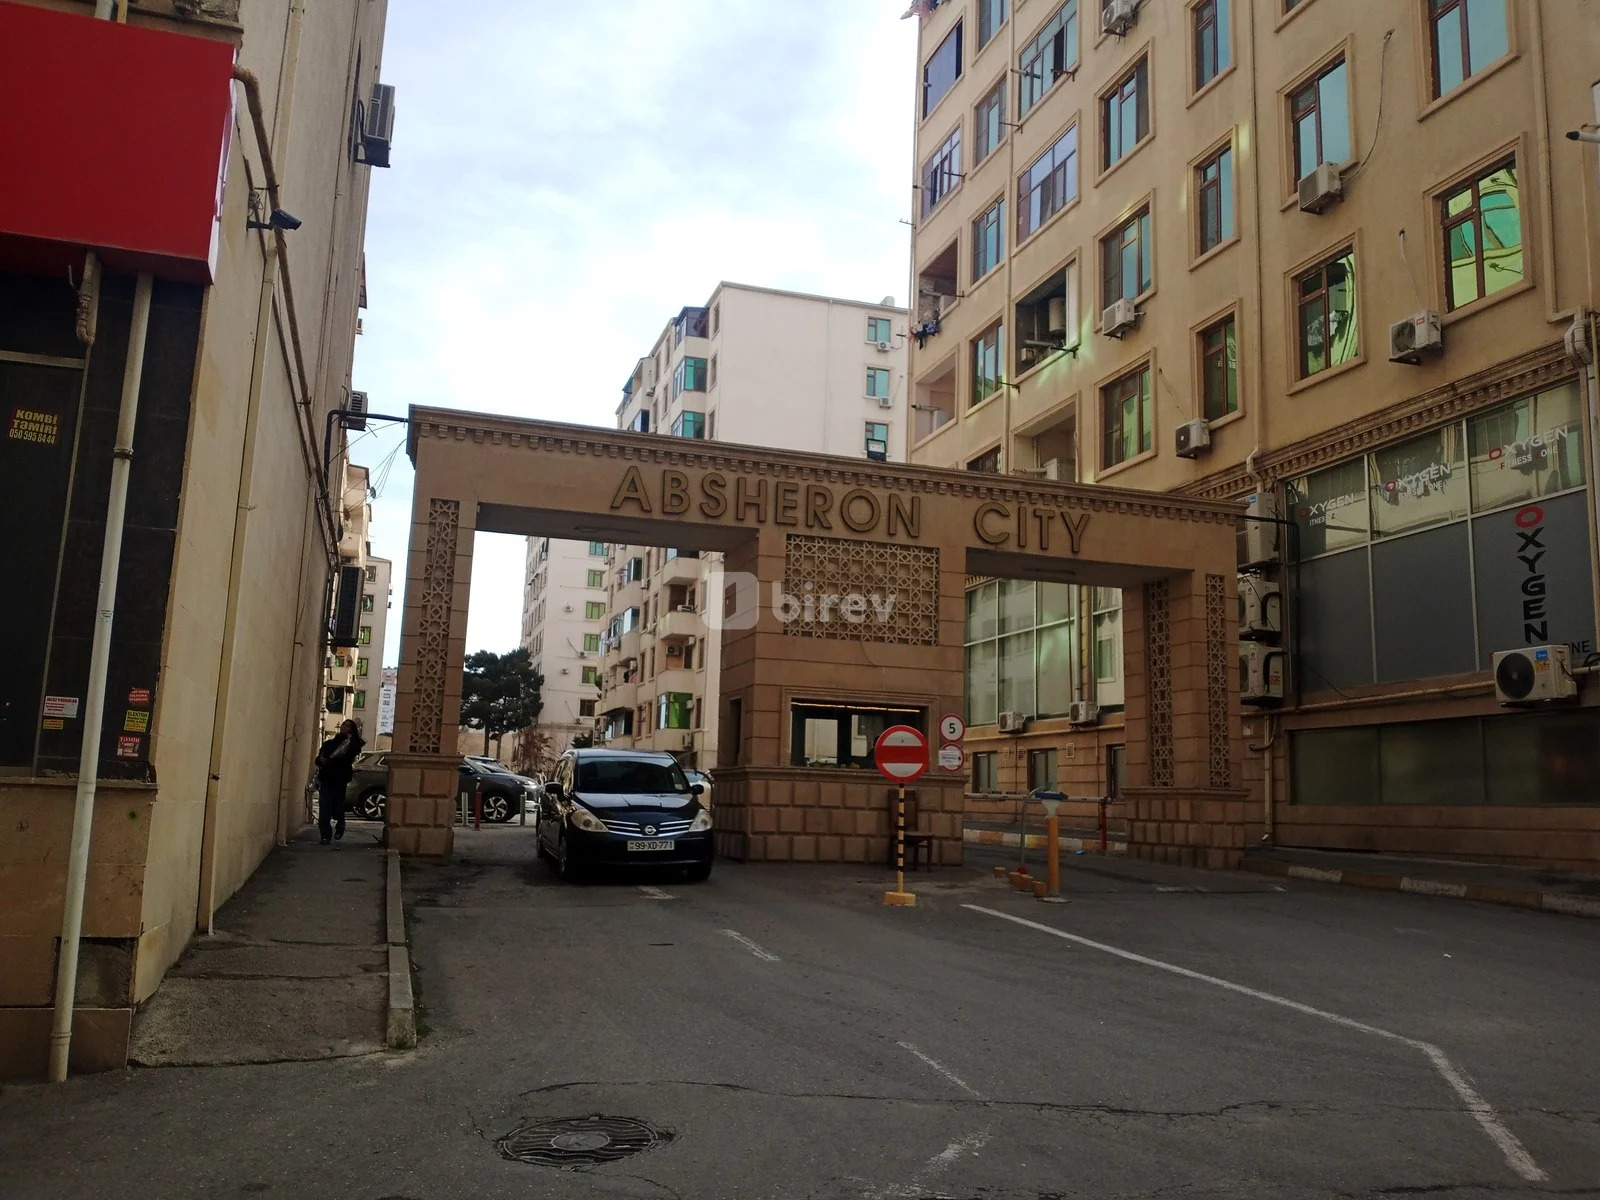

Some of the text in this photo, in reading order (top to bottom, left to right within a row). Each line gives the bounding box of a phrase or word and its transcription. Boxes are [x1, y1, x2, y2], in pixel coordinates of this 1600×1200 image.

[9, 428, 23, 439] 050
[23, 430, 37, 442] 595
[1488, 425, 1568, 459] OXYGEN
[1500, 453, 1532, 469] FITNESS
[1384, 464, 1451, 491] OXYGEN
[610, 465, 1090, 553] ABSHERON CITY
[1299, 493, 1354, 517] OXYGEN
[1514, 505, 1549, 645] OXYGEN
[949, 723, 956, 734] 5
